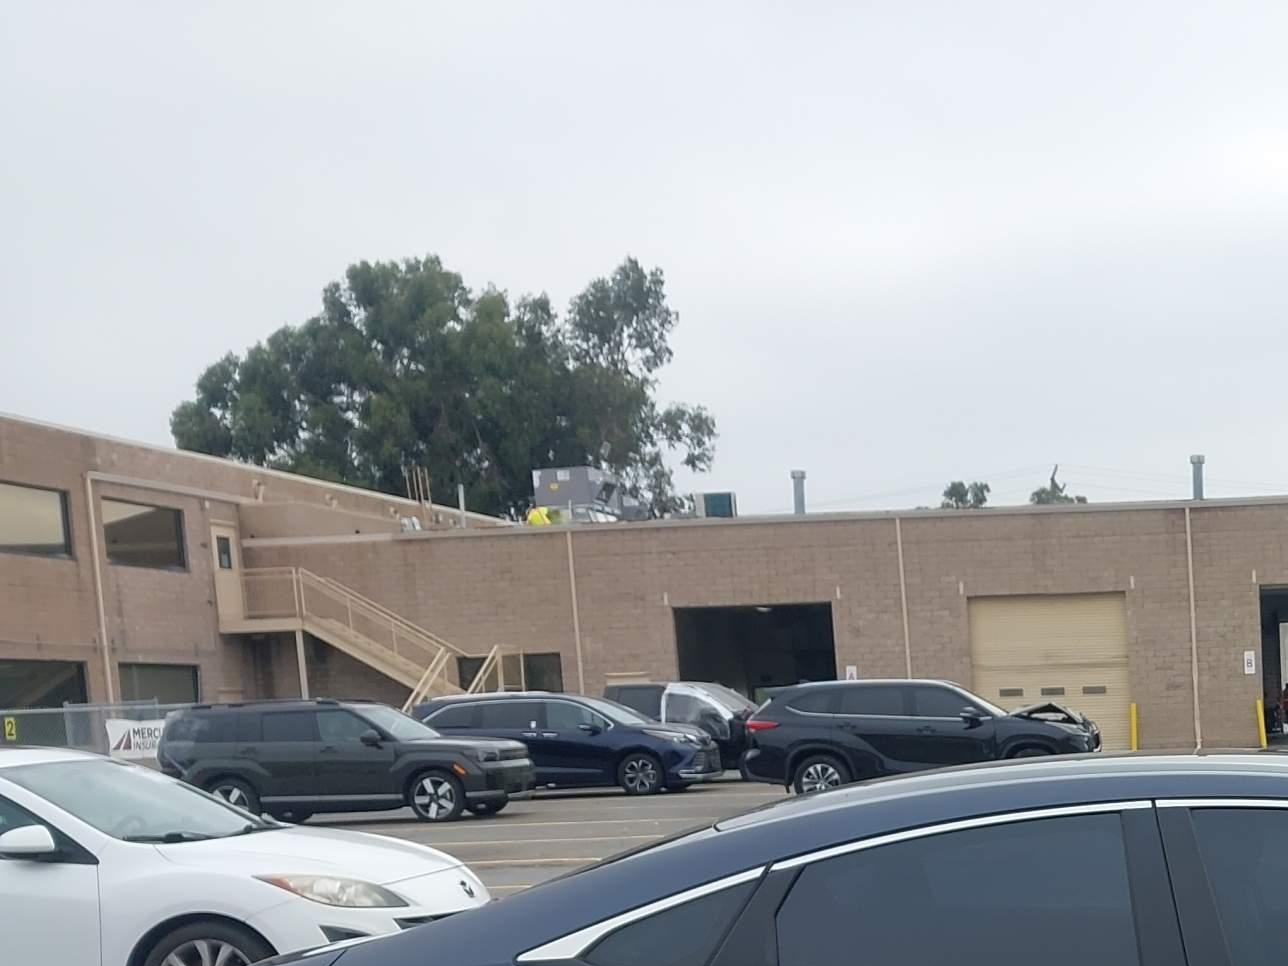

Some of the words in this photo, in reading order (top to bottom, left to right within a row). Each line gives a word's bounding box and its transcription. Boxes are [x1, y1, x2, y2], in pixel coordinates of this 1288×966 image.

[1247, 658, 1253, 668] B
[848, 671, 855, 680] A
[7, 720, 14, 736] 2
